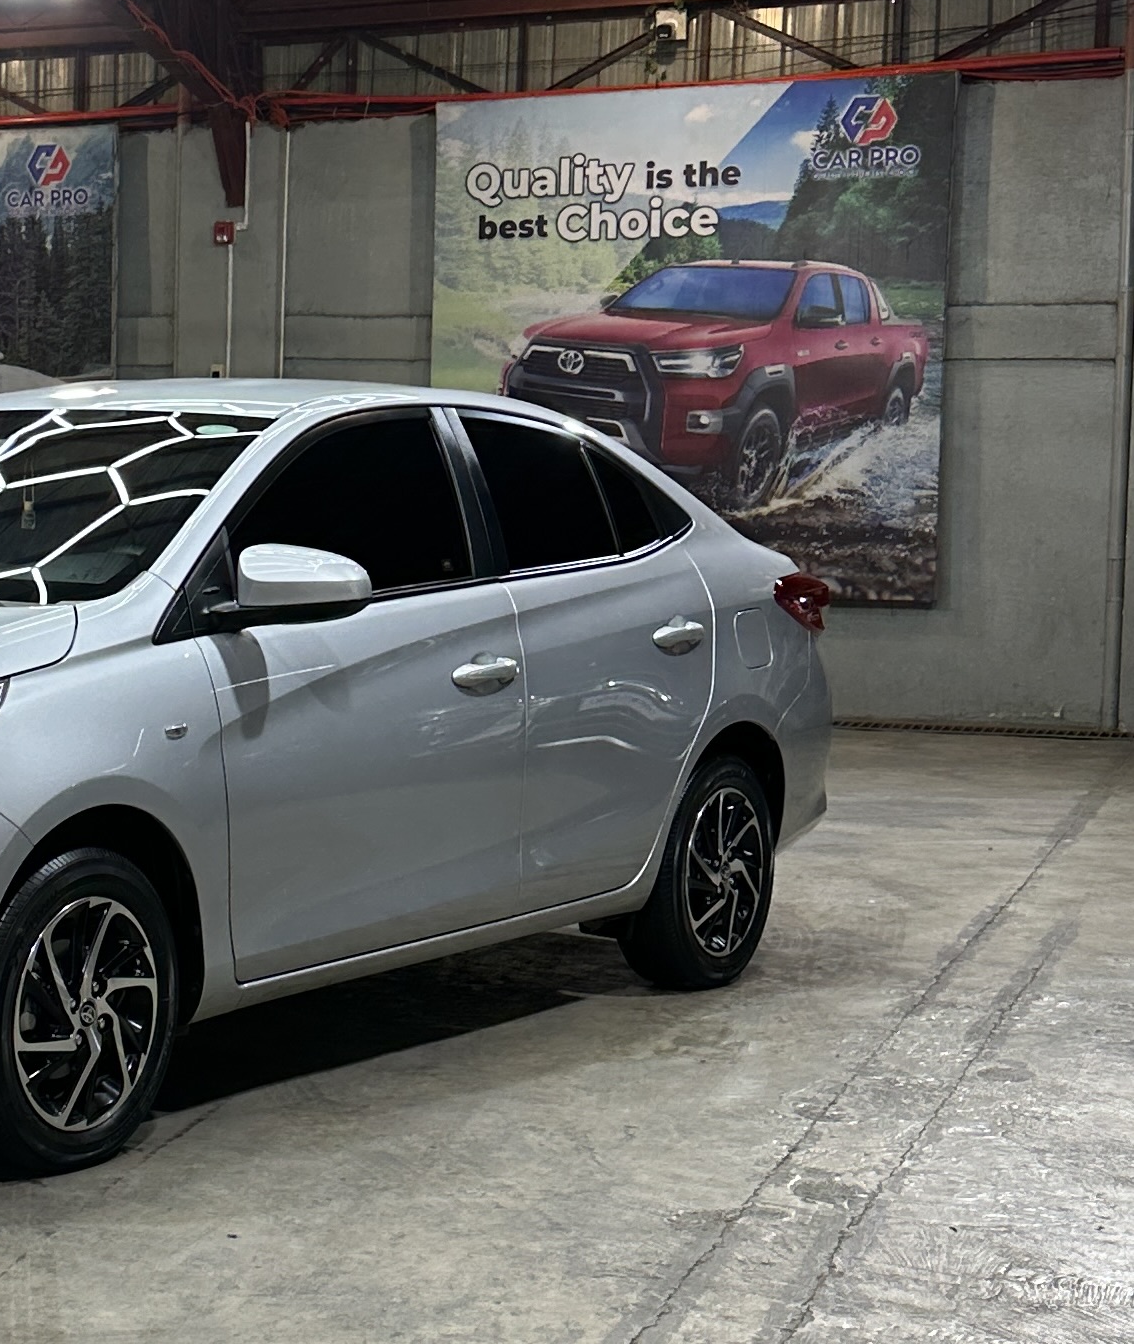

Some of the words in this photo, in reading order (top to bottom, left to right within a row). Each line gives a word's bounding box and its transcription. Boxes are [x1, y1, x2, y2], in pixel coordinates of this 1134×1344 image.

[813, 148, 862, 170] CAR
[870, 146, 921, 167] PRO
[7, 190, 44, 207] CAR
[51, 188, 88, 205] PRO
[466, 153, 635, 207] Quality
[646, 161, 673, 189] is
[683, 160, 742, 187] the
[478, 214, 548, 240] best
[556, 195, 719, 242] Choice
